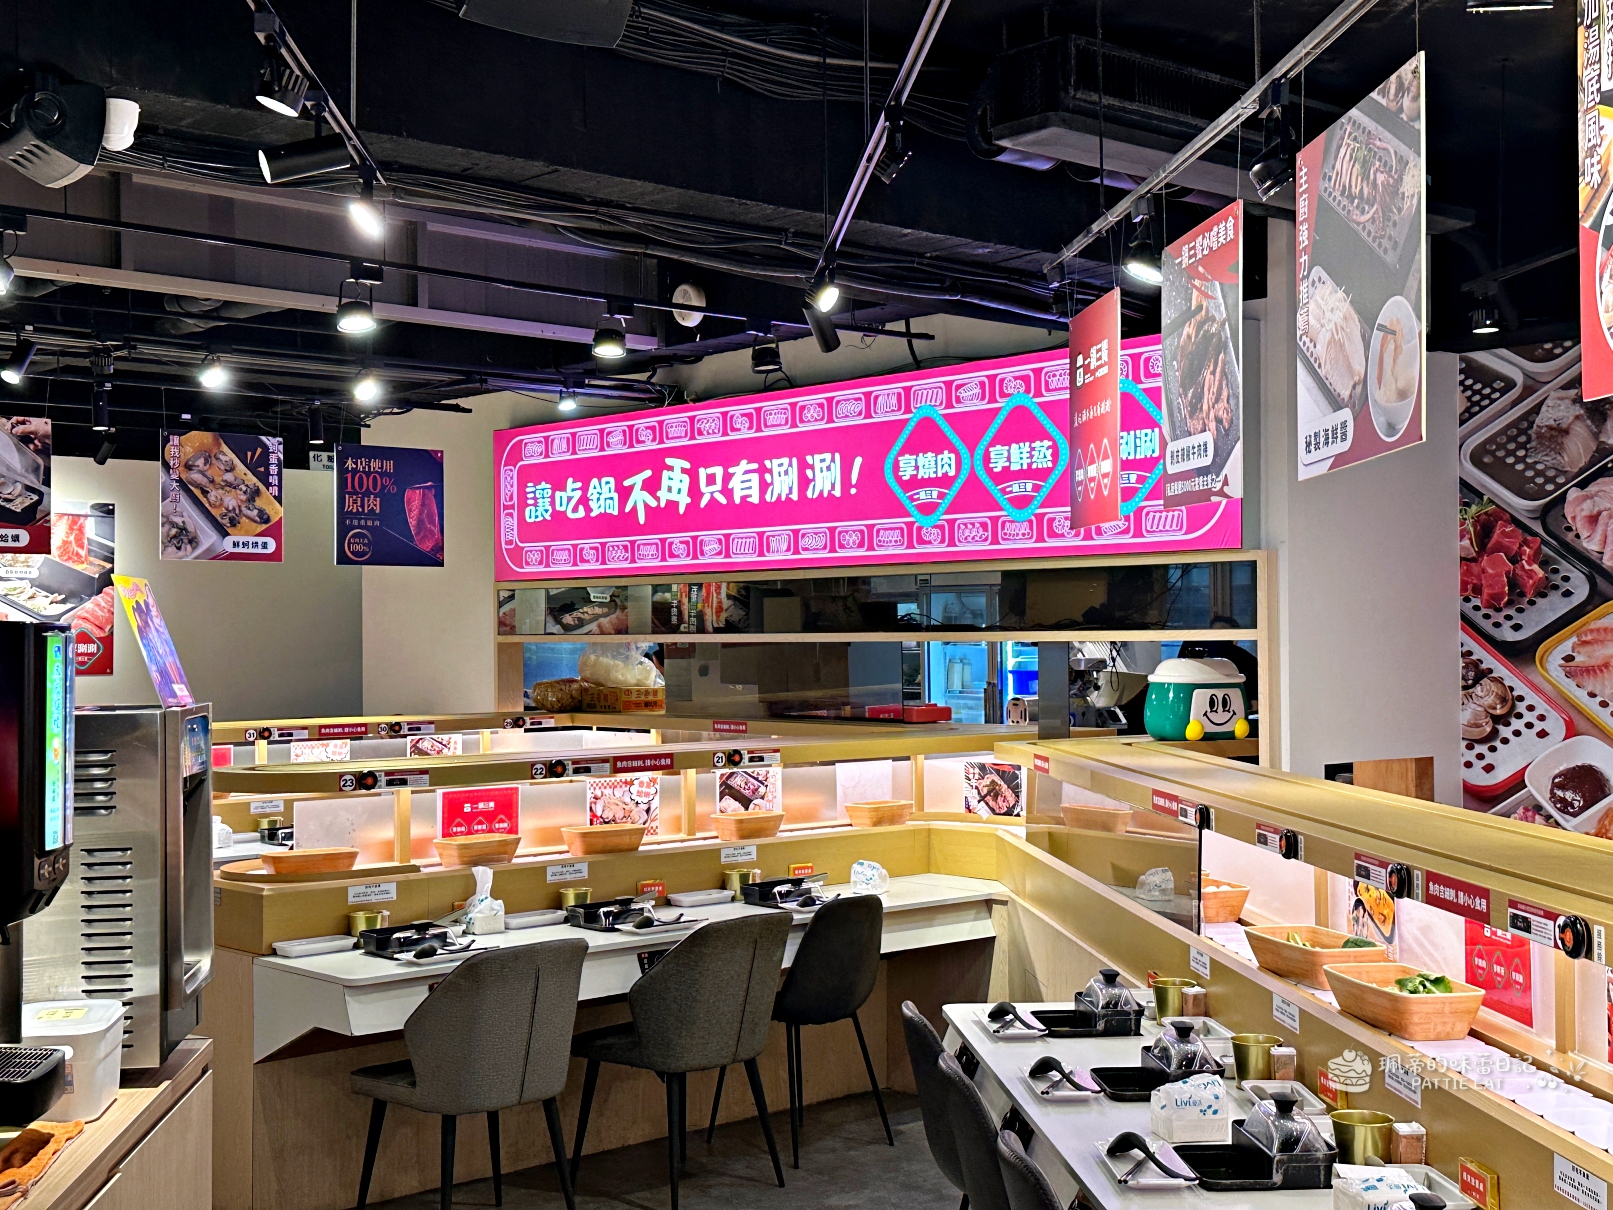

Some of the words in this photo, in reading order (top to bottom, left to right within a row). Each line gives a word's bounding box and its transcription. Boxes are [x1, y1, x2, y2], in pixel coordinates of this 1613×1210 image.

[343, 456, 394, 473] 本店使用
[988, 439, 1053, 473] 享鮮蒸
[897, 450, 956, 481] 享燒肉
[344, 472, 397, 493] 100%
[344, 494, 381, 513] 原肉
[715, 755, 724, 764] 21
[533, 767, 546, 776] 22
[341, 778, 355, 787] 23
